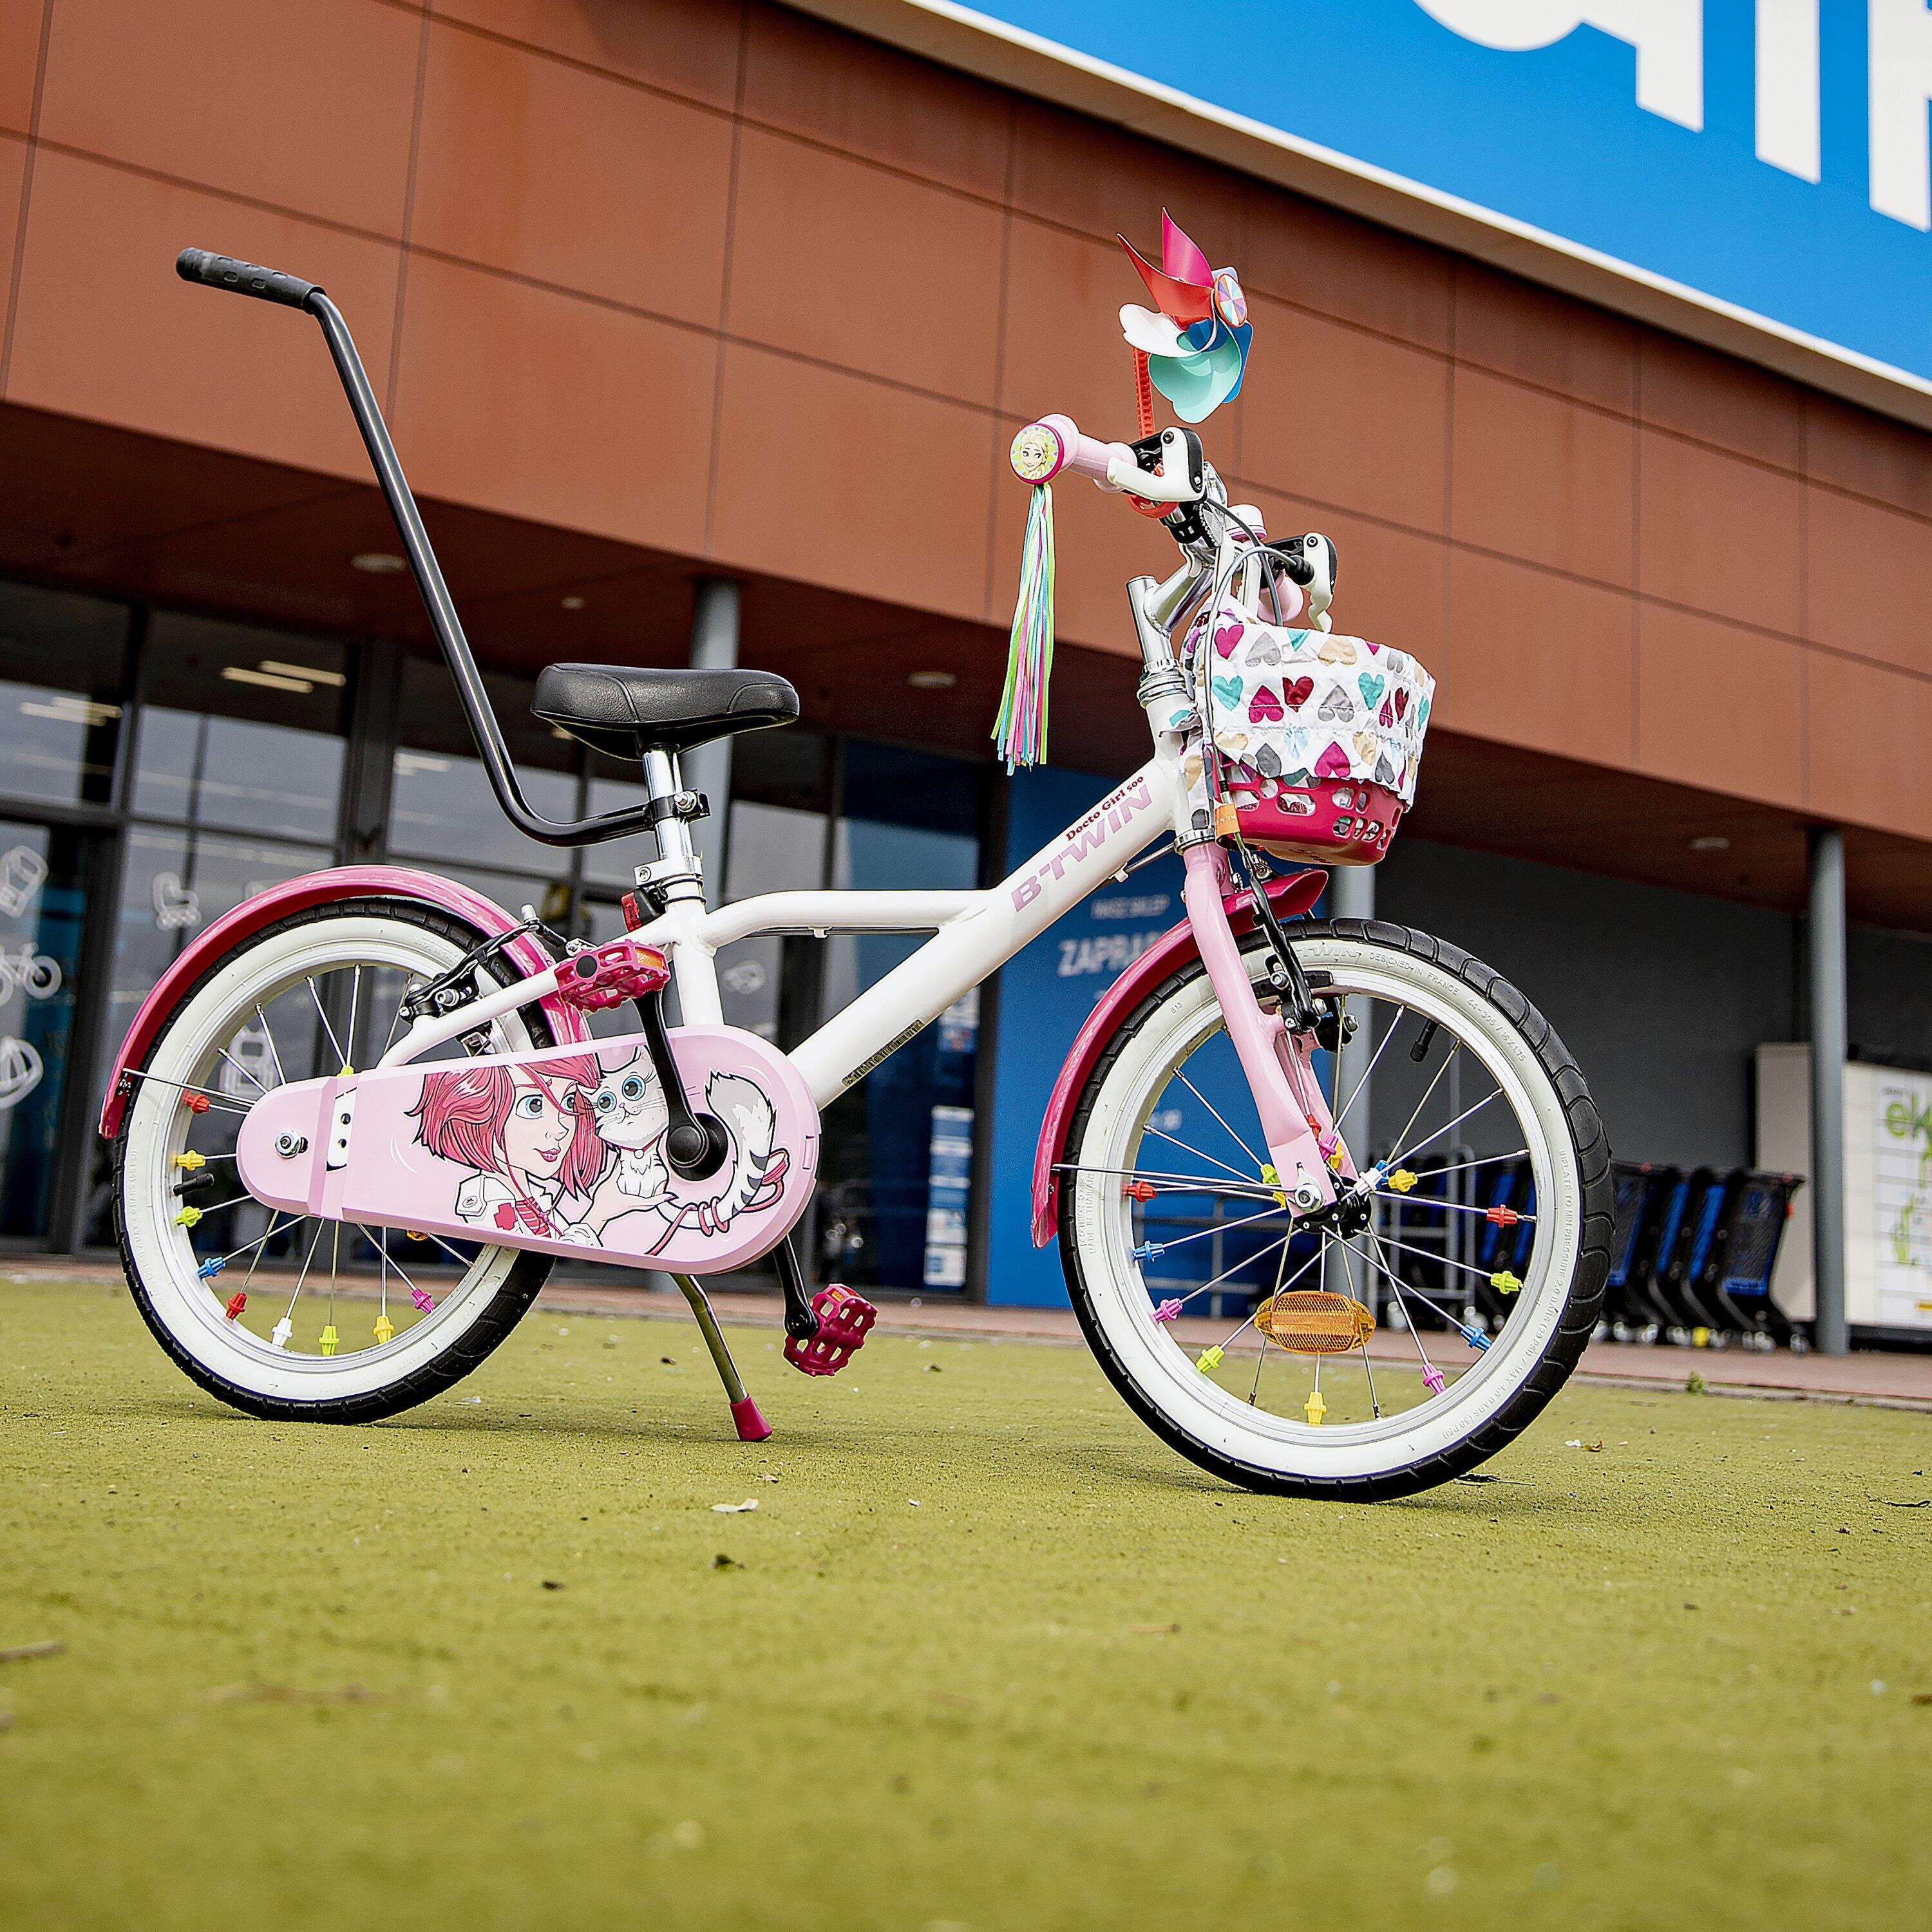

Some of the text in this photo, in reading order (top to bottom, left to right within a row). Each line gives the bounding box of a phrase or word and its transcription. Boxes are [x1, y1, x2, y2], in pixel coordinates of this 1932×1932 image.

[1066, 811, 1101, 841] Docto
[1102, 790, 1126, 810] Girl
[1369, 952, 1411, 970] DESIGNED
[1414, 965, 1423, 976] IN
[1426, 972, 1461, 996] FRANCE
[1467, 998, 1497, 1026] 44-305
[1558, 1149, 1572, 1191] INFLATE
[1565, 1195, 1573, 1207] TO
[1558, 1228, 1572, 1278] PRESSURE
[1553, 1280, 1564, 1294] 2.0
[1526, 1340, 1539, 1357] PSI)
[1506, 1365, 1523, 1385] MAX
[1443, 1426, 1459, 1440] PSI)
